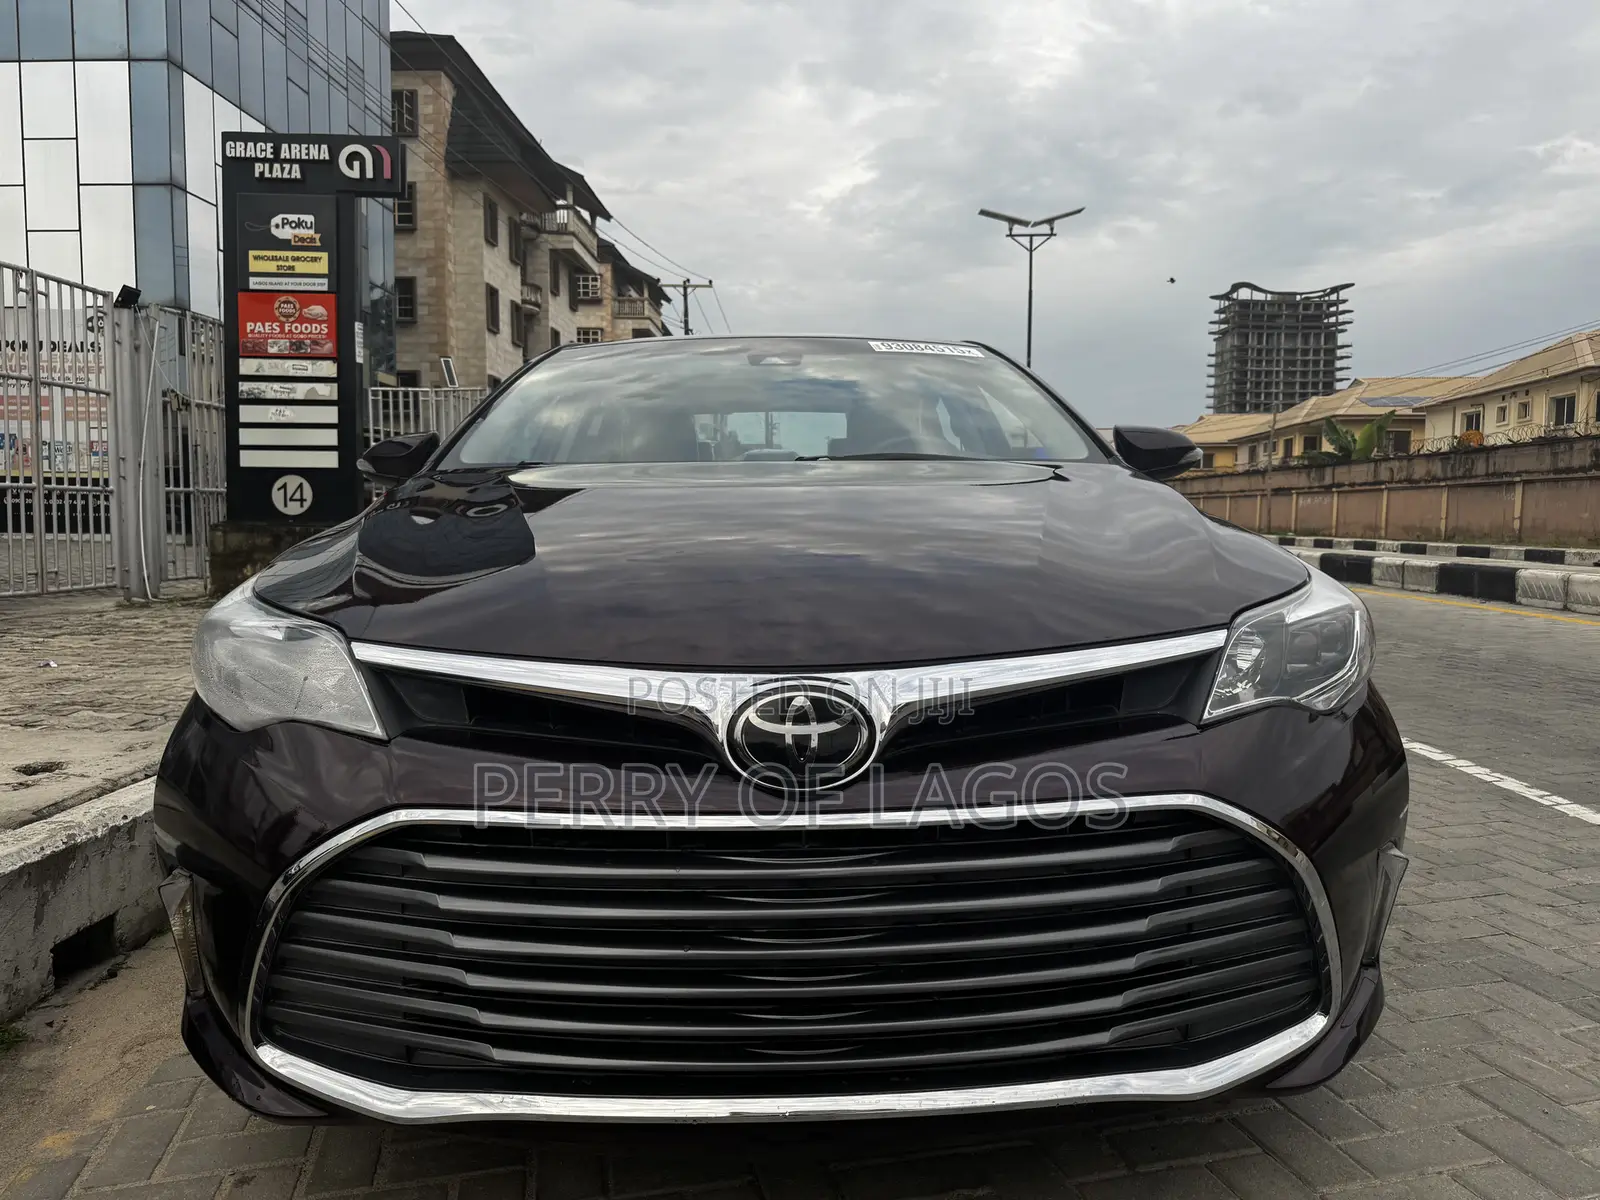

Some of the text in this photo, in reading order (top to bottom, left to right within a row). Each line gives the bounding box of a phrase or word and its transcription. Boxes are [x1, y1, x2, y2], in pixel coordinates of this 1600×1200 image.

[225, 141, 330, 160] GRACE ARENA
[254, 163, 301, 179] PLAZA
[281, 217, 314, 230] Poku
[293, 235, 317, 244] Deals
[246, 322, 328, 334] PAES FOODS
[277, 482, 307, 508] 14
